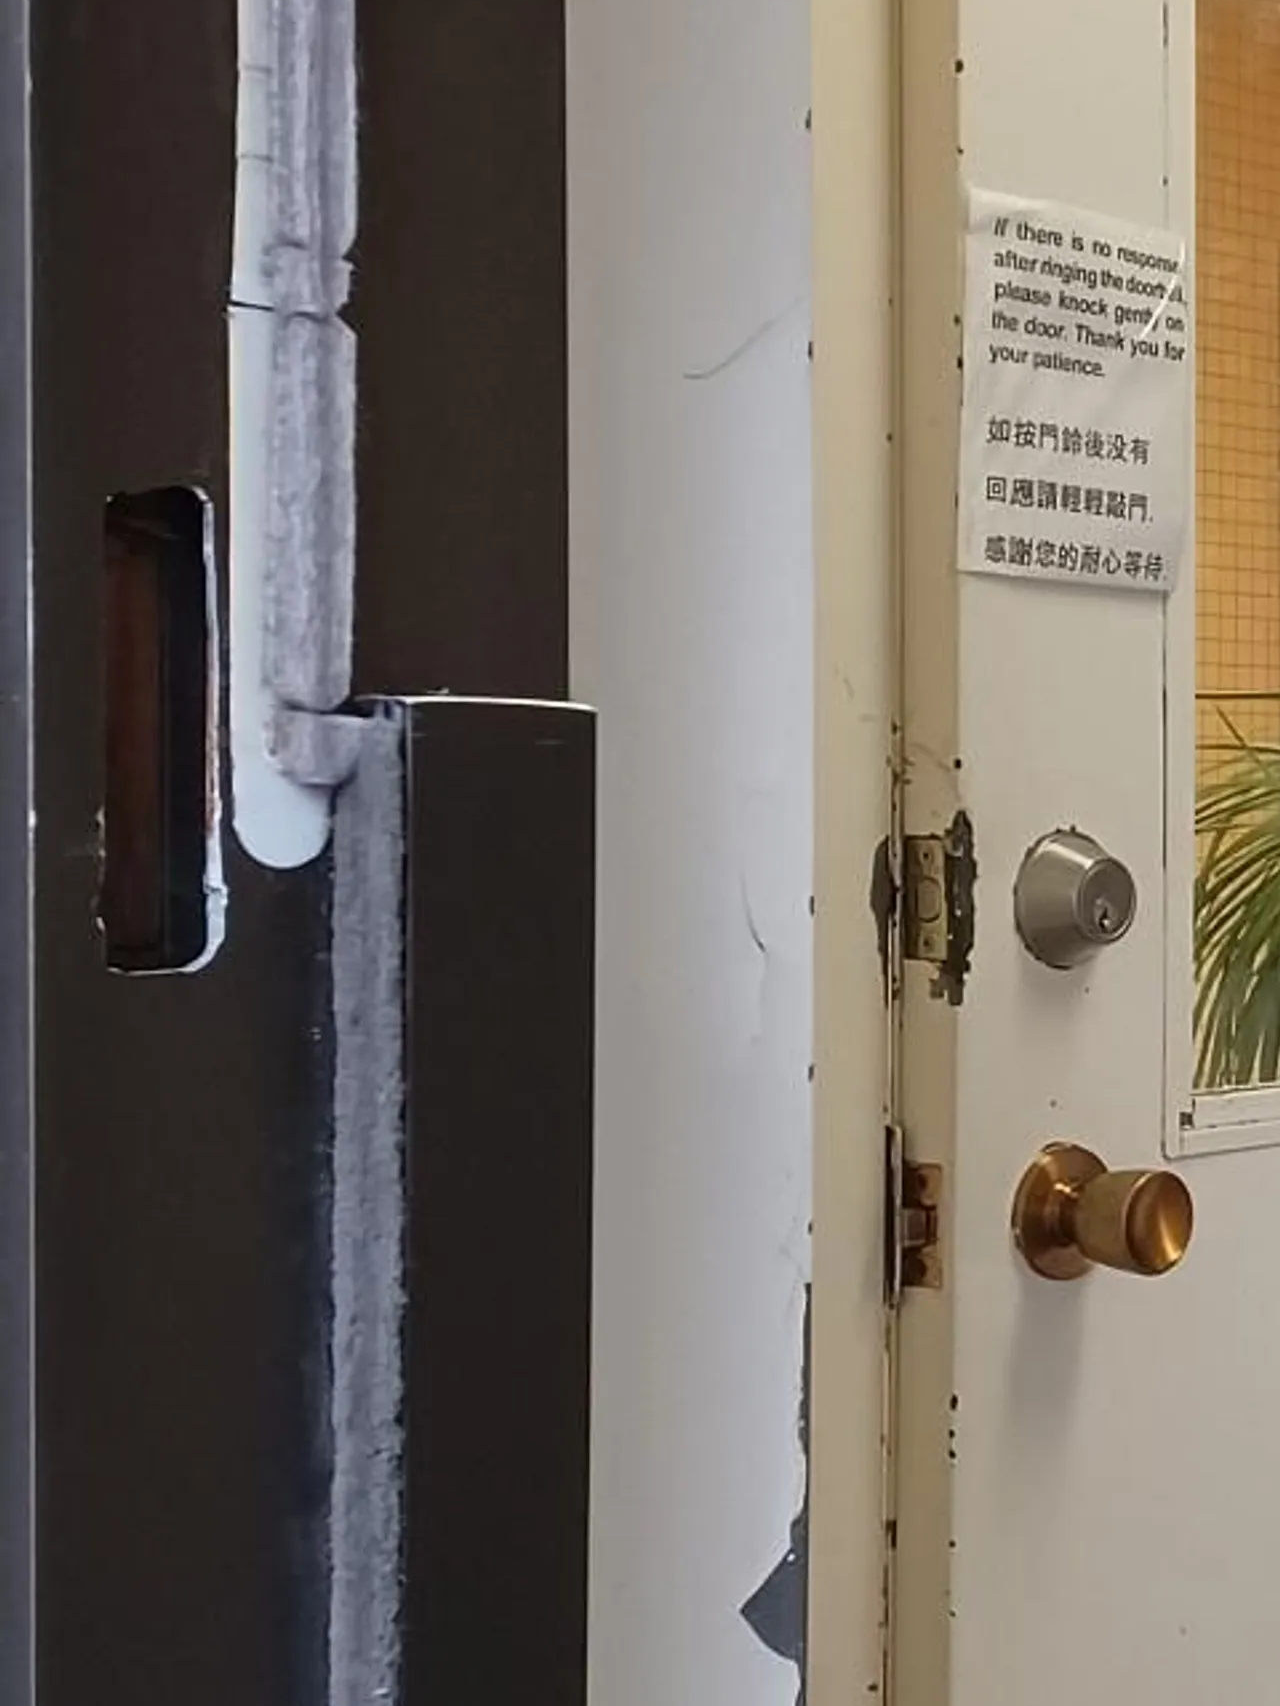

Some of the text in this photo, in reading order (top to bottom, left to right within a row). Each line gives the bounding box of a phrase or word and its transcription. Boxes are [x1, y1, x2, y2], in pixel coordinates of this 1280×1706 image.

[994, 217, 1009, 237] If
[1016, 221, 1063, 247] there
[1072, 229, 1084, 251] is
[1093, 240, 1112, 257] no
[993, 249, 1039, 272] after
[1040, 256, 1098, 289] ringing
[1100, 269, 1123, 291] the
[994, 280, 1185, 332] please knock genty on
[989, 344, 1028, 364] your
[991, 310, 1019, 331] the
[1075, 323, 1125, 351] Thank
[1130, 338, 1159, 358] you
[1164, 341, 1186, 361] for
